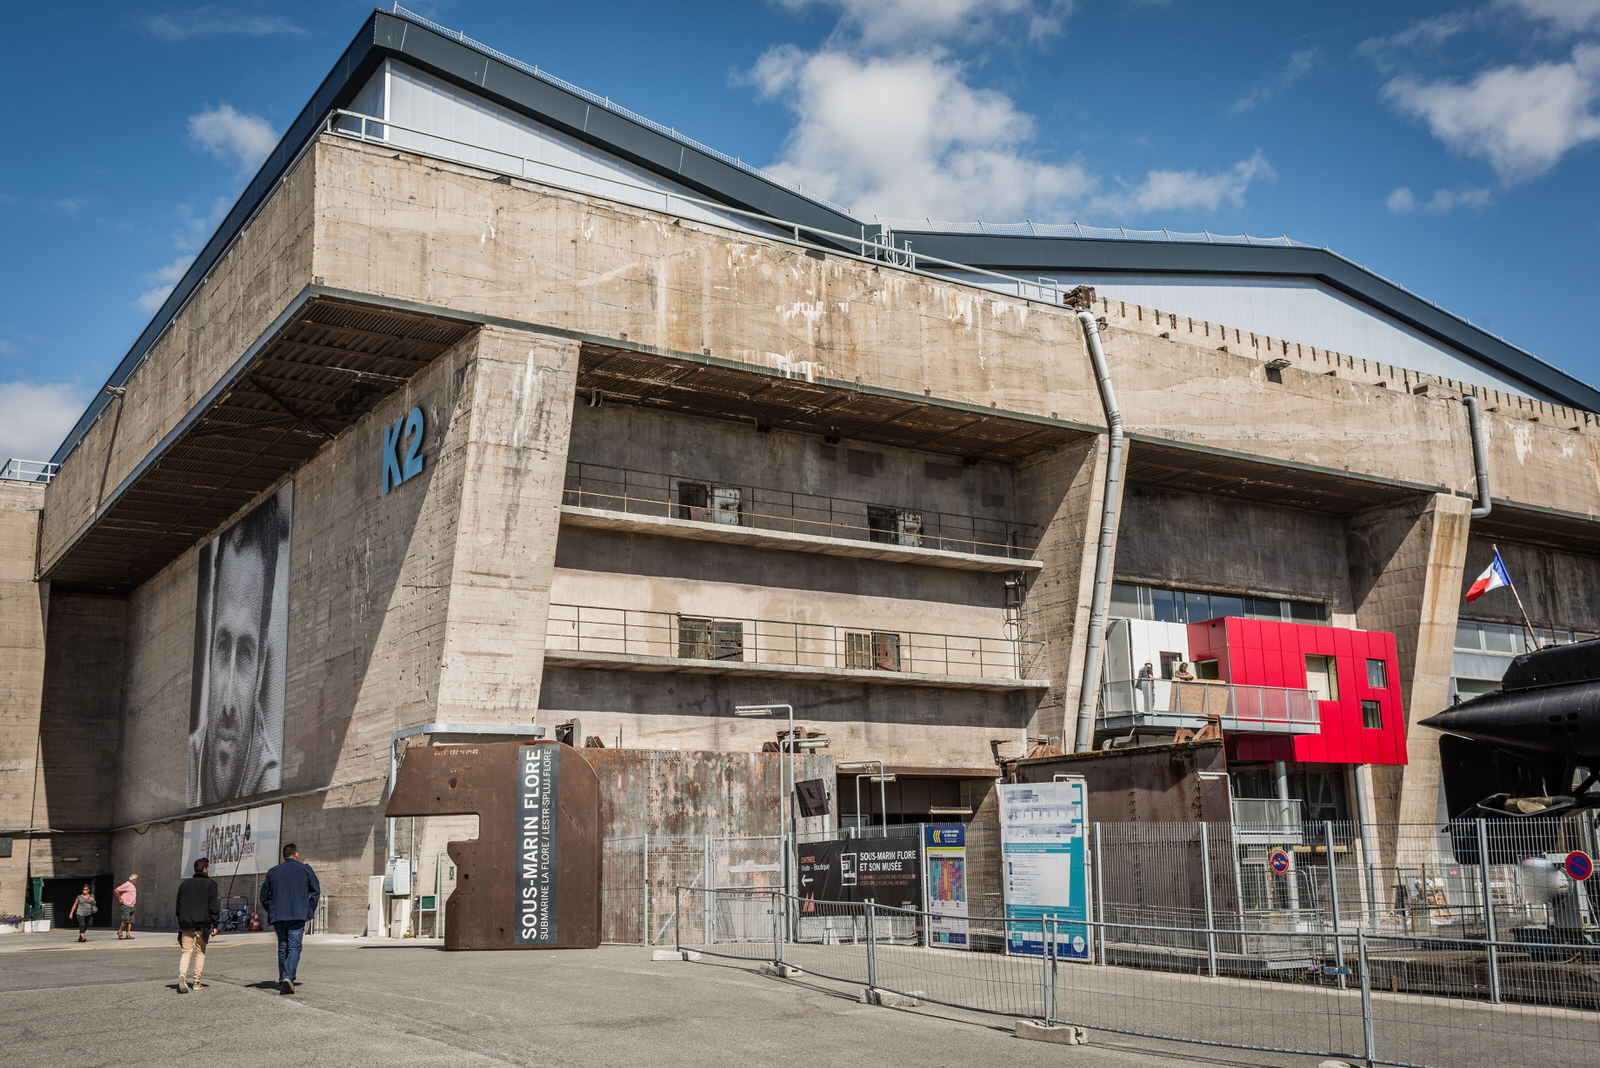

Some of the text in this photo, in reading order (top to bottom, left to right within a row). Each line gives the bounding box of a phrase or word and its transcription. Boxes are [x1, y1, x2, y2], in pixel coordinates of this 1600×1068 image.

[382, 407, 424, 495] K2
[542, 749, 552, 776] FLORE
[542, 779, 551, 834] LESTR-SPLUJ
[206, 824, 241, 864] VISAGES
[522, 749, 541, 940] SOUS-MARIN FLORE
[541, 842, 550, 870] FLORE
[860, 850, 917, 861] SOUS-MARIN FLORE
[541, 872, 549, 883] LA
[813, 863, 830, 871] Boutique
[860, 860, 902, 871] ET SON MUSÉE
[540, 885, 549, 940] SUBMARINE
